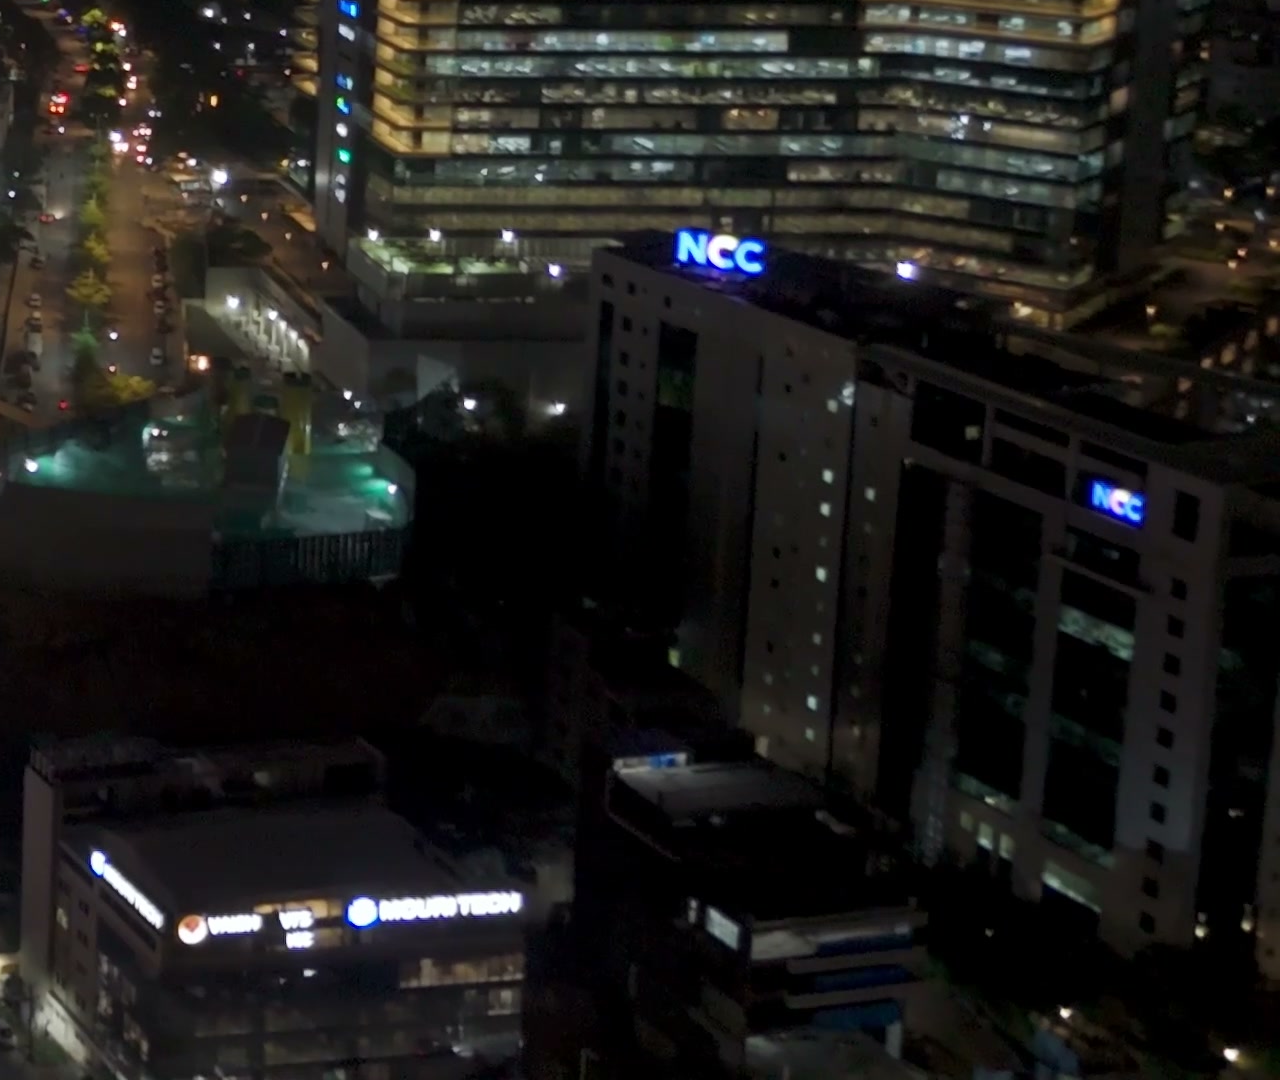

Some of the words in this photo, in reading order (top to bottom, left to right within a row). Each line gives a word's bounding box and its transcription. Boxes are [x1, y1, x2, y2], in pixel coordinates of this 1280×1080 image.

[677, 229, 765, 273] NCC
[1091, 481, 1144, 522] NCC
[458, 891, 524, 918] TECH
